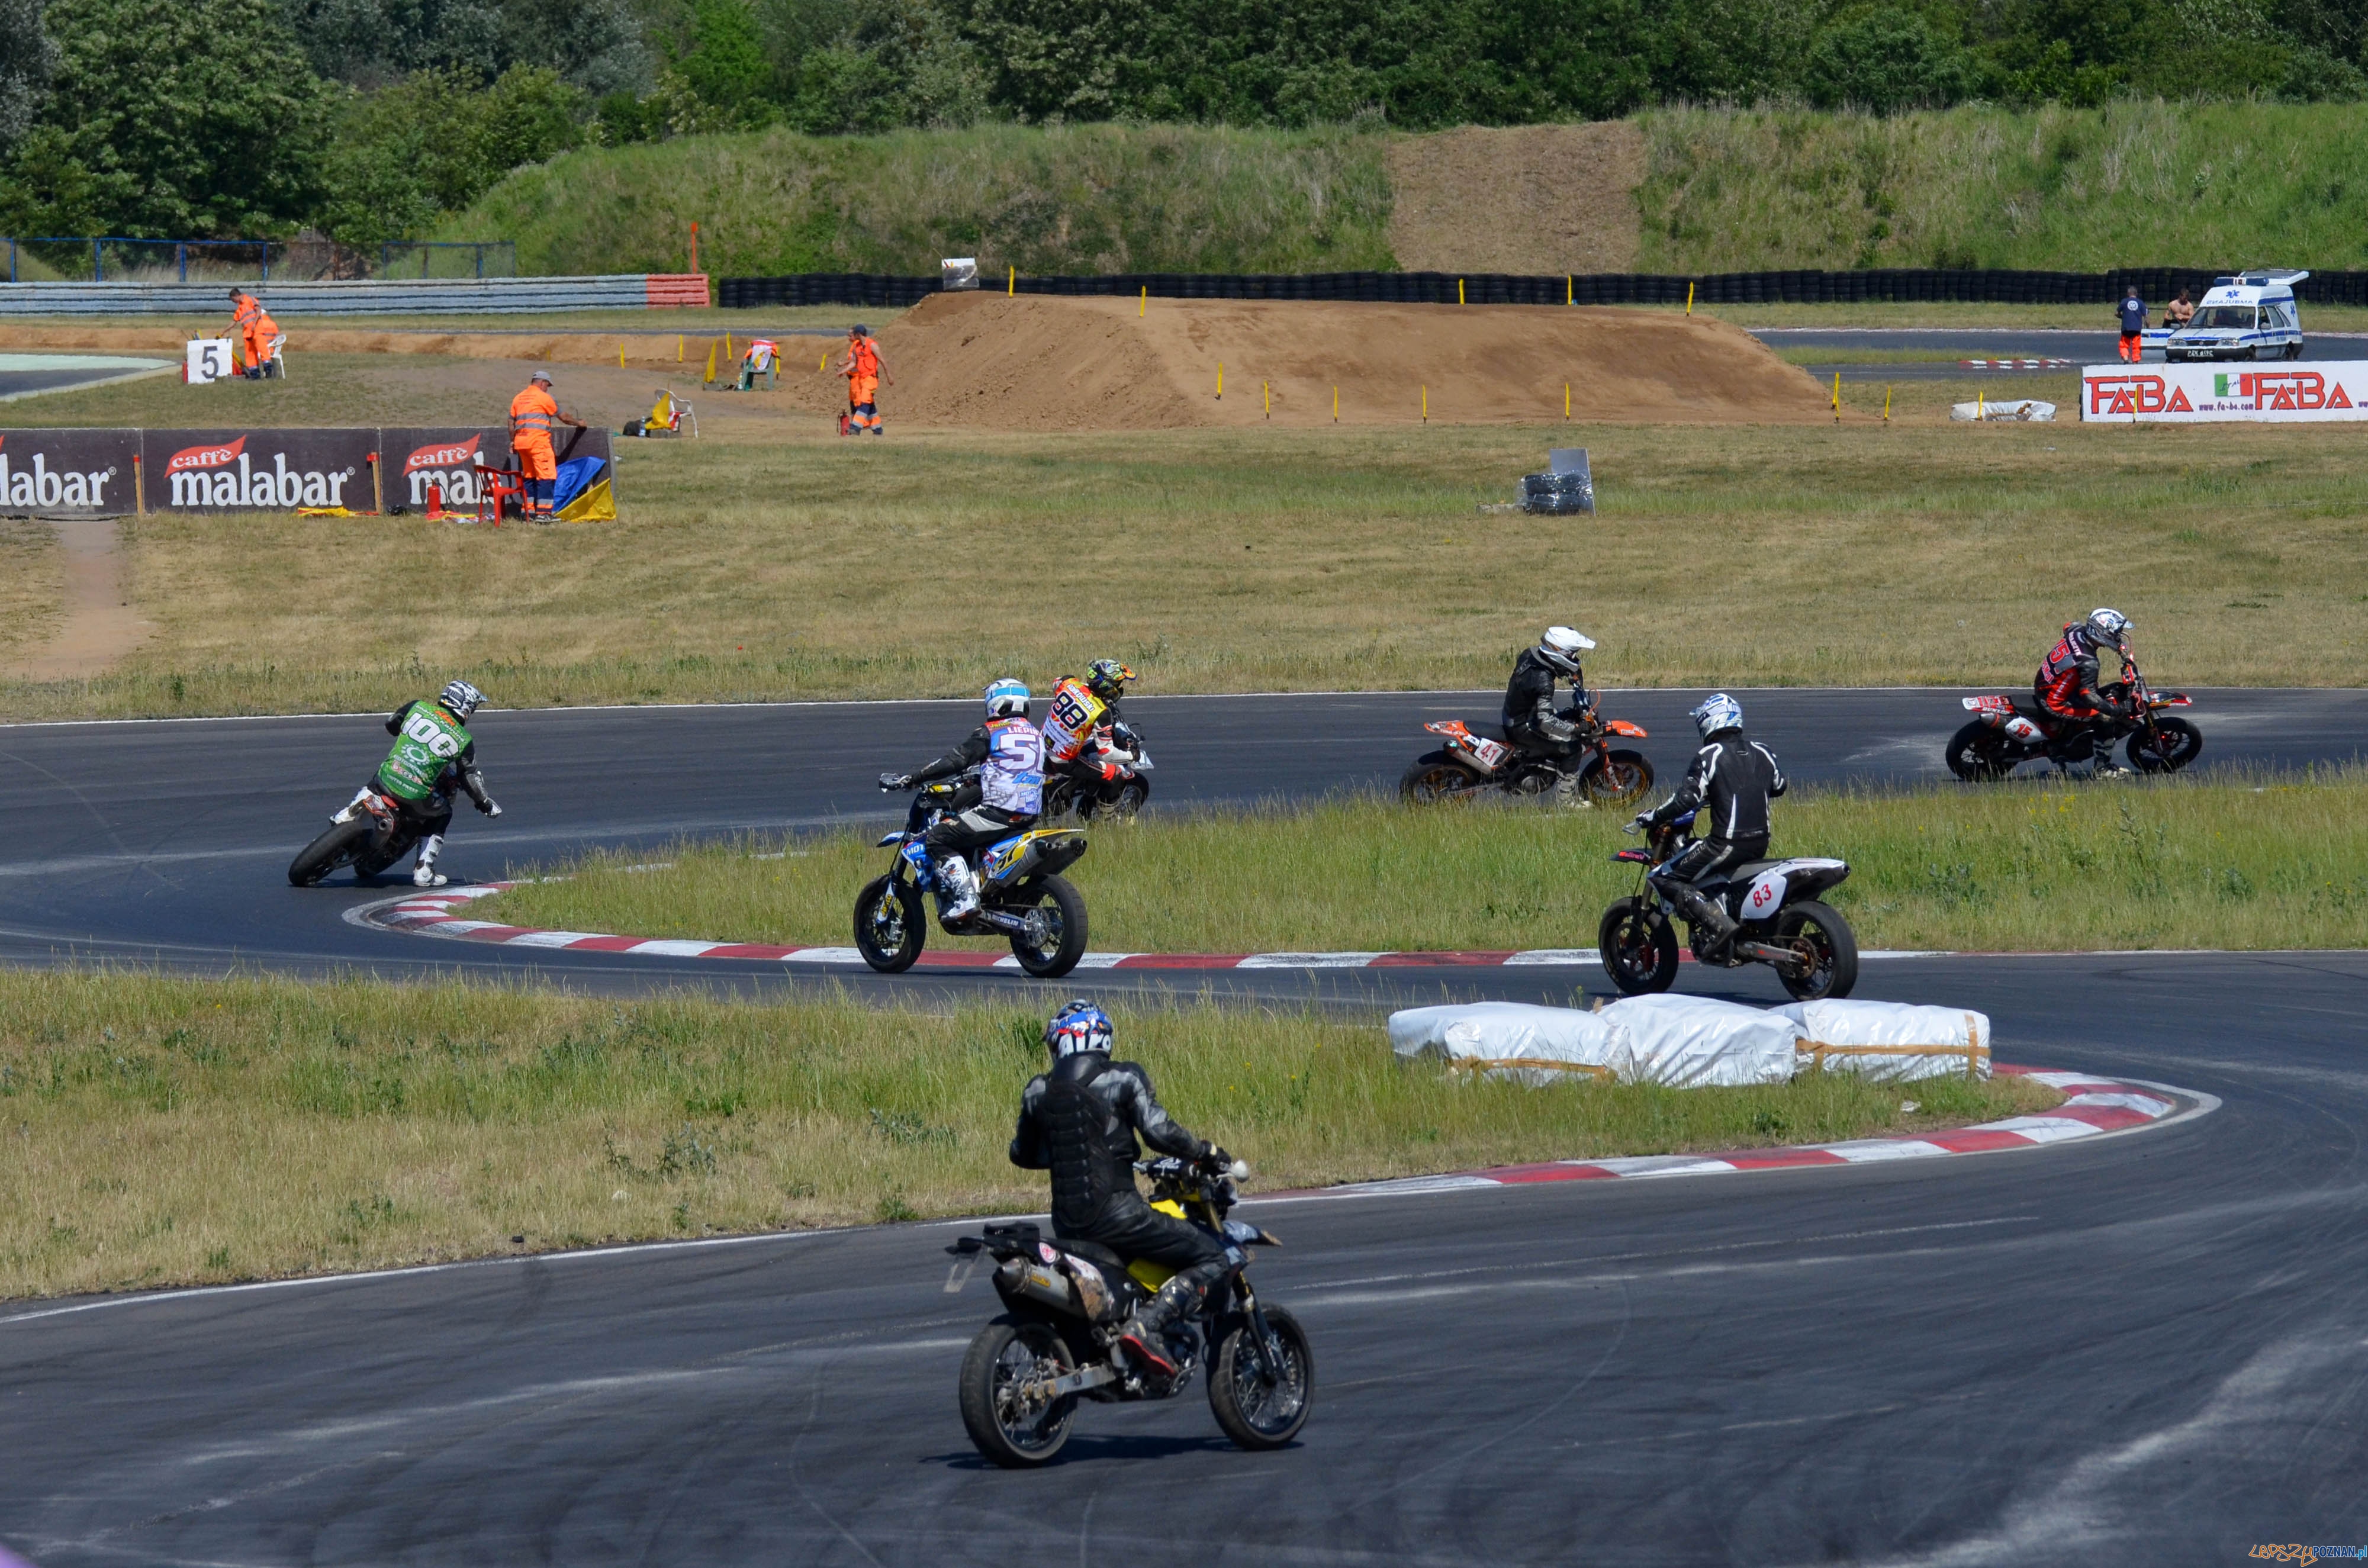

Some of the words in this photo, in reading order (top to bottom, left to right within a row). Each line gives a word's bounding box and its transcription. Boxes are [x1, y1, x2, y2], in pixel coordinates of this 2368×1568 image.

[201, 346, 219, 379] 5
[172, 448, 233, 469] caffè
[409, 447, 469, 466] caffè
[170, 452, 348, 507] malabar
[2015, 723, 2034, 739] 15
[1479, 745, 1499, 762] 41
[1752, 884, 1772, 908] 83
